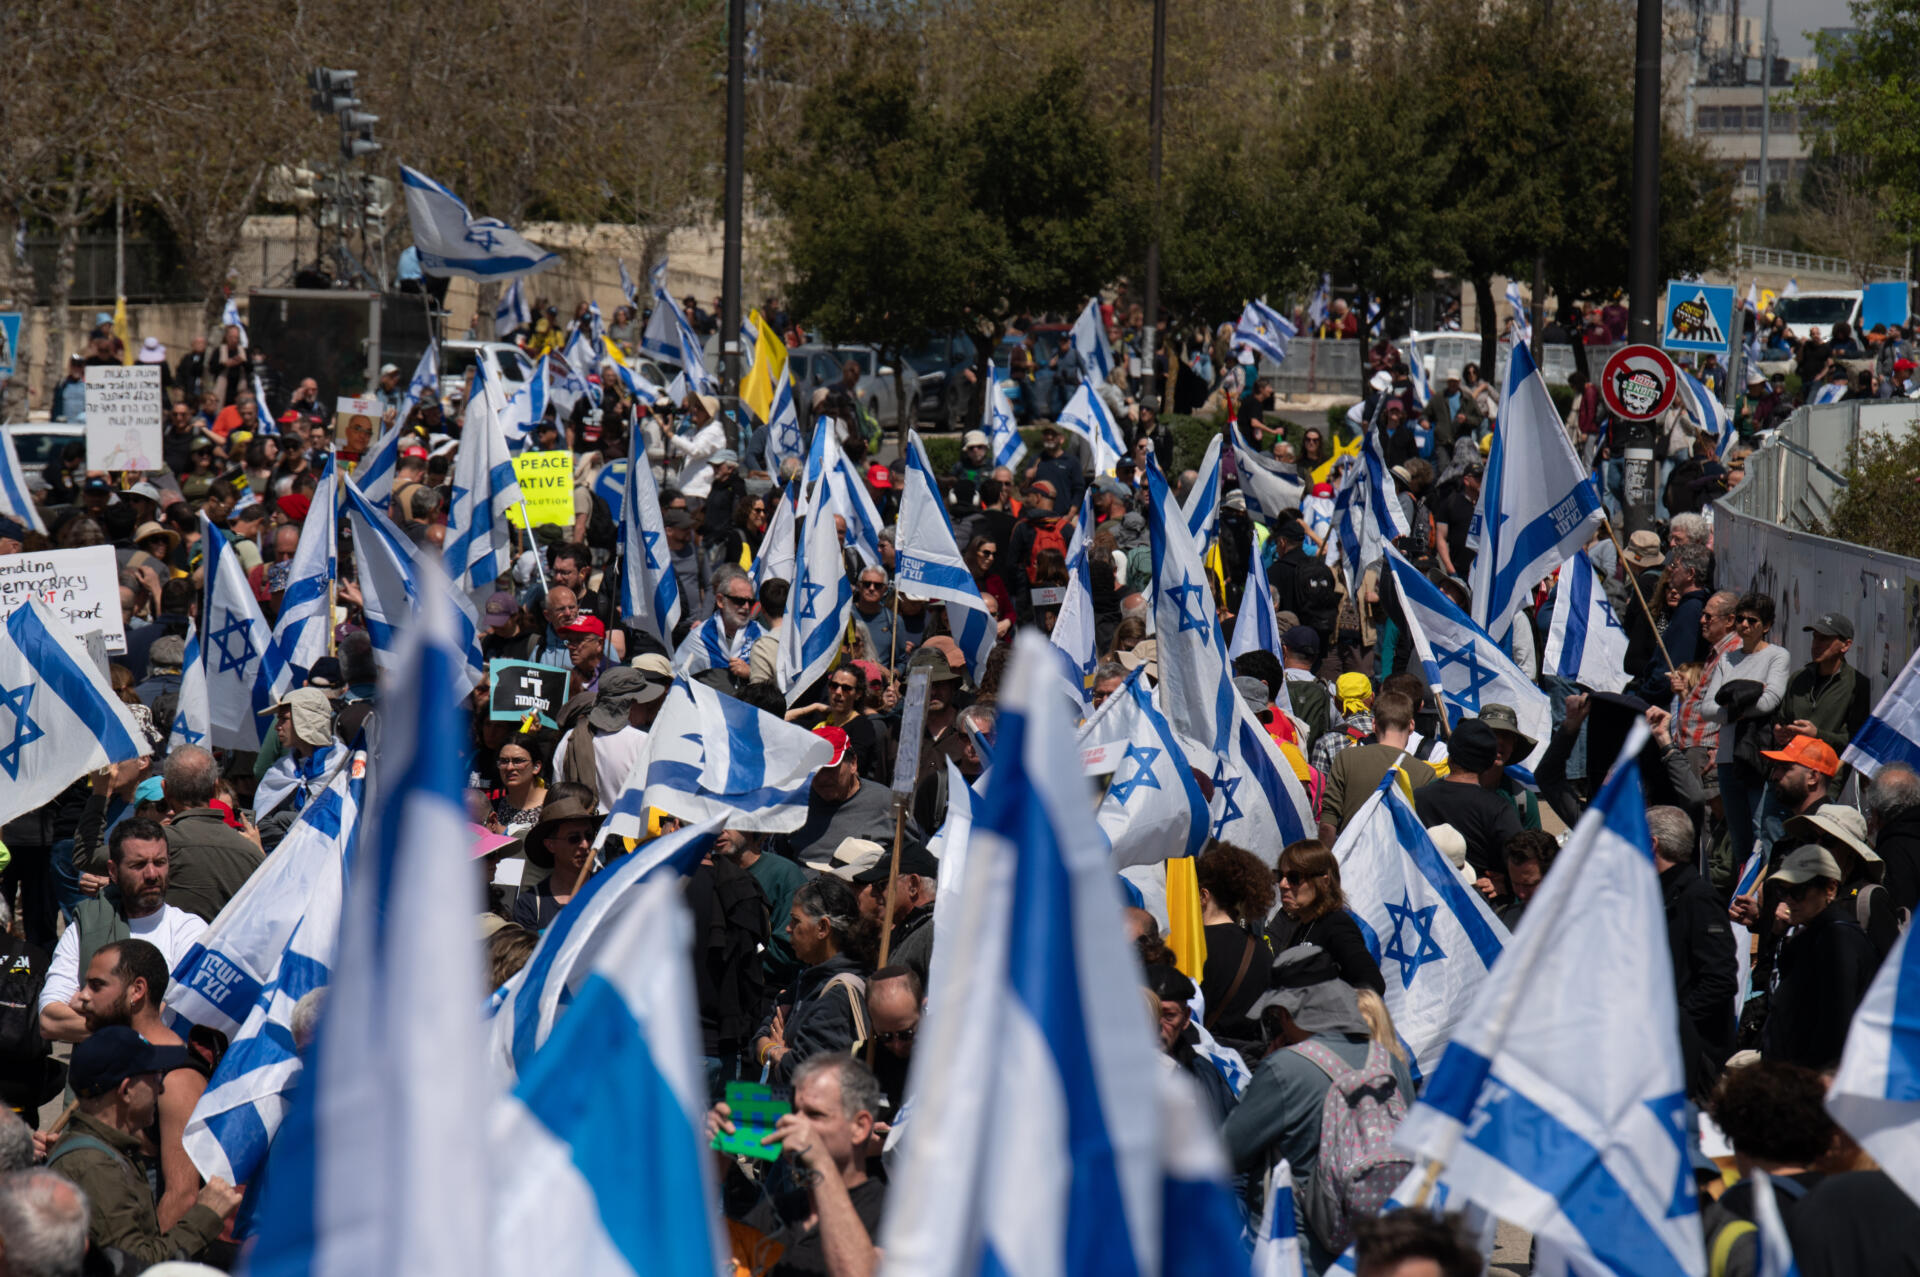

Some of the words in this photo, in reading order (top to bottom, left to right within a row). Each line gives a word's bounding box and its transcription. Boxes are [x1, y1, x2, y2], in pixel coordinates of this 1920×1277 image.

[520, 457, 569, 470] PEACE
[519, 476, 565, 489] ATIVE
[524, 498, 568, 506] OLUTION
[1548, 495, 1578, 520] חופשי
[1554, 507, 1583, 537] בארצנו
[63, 590, 75, 602] A
[520, 676, 543, 698] די
